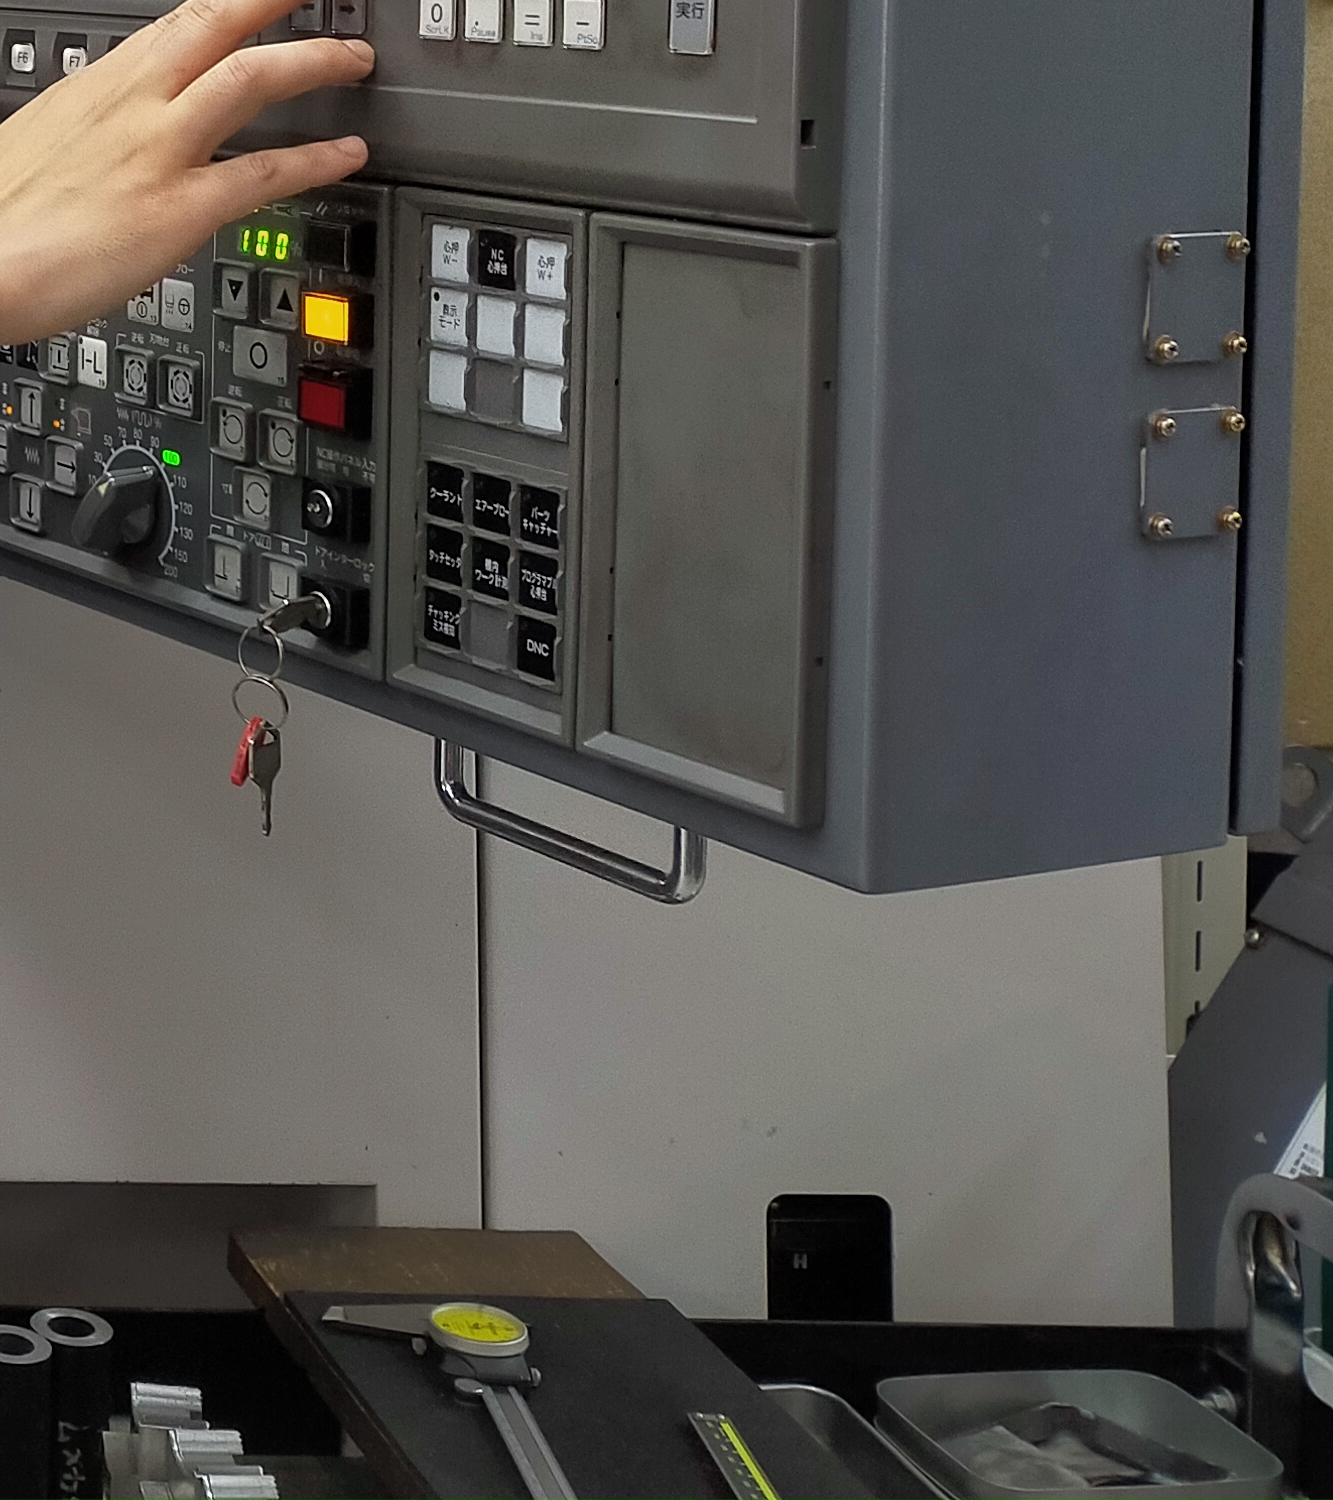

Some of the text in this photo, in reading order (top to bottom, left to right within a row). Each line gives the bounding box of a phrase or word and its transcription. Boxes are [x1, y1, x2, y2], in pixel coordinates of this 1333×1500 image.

[431, 3, 442, 23] 0
[676, 1, 705, 21] 実行
[17, 51, 28, 63] F6
[69, 57, 80, 67] F7
[242, 229, 289, 260] 100
[491, 248, 504, 260] NC
[537, 270, 553, 280] W+
[118, 427, 127, 438] 70
[133, 429, 142, 440] 80
[104, 435, 113, 447] 50
[150, 436, 159, 448] 90
[94, 451, 103, 462] 30
[88, 474, 97, 485] 10
[173, 475, 186, 488] 110
[430, 487, 462, 506] クーラント
[179, 502, 192, 514] 120
[531, 506, 550, 521] パーツ
[179, 527, 193, 540] 130
[174, 549, 188, 562] 150
[429, 550, 461, 569] タッチセッタ
[526, 639, 549, 656] DNC
